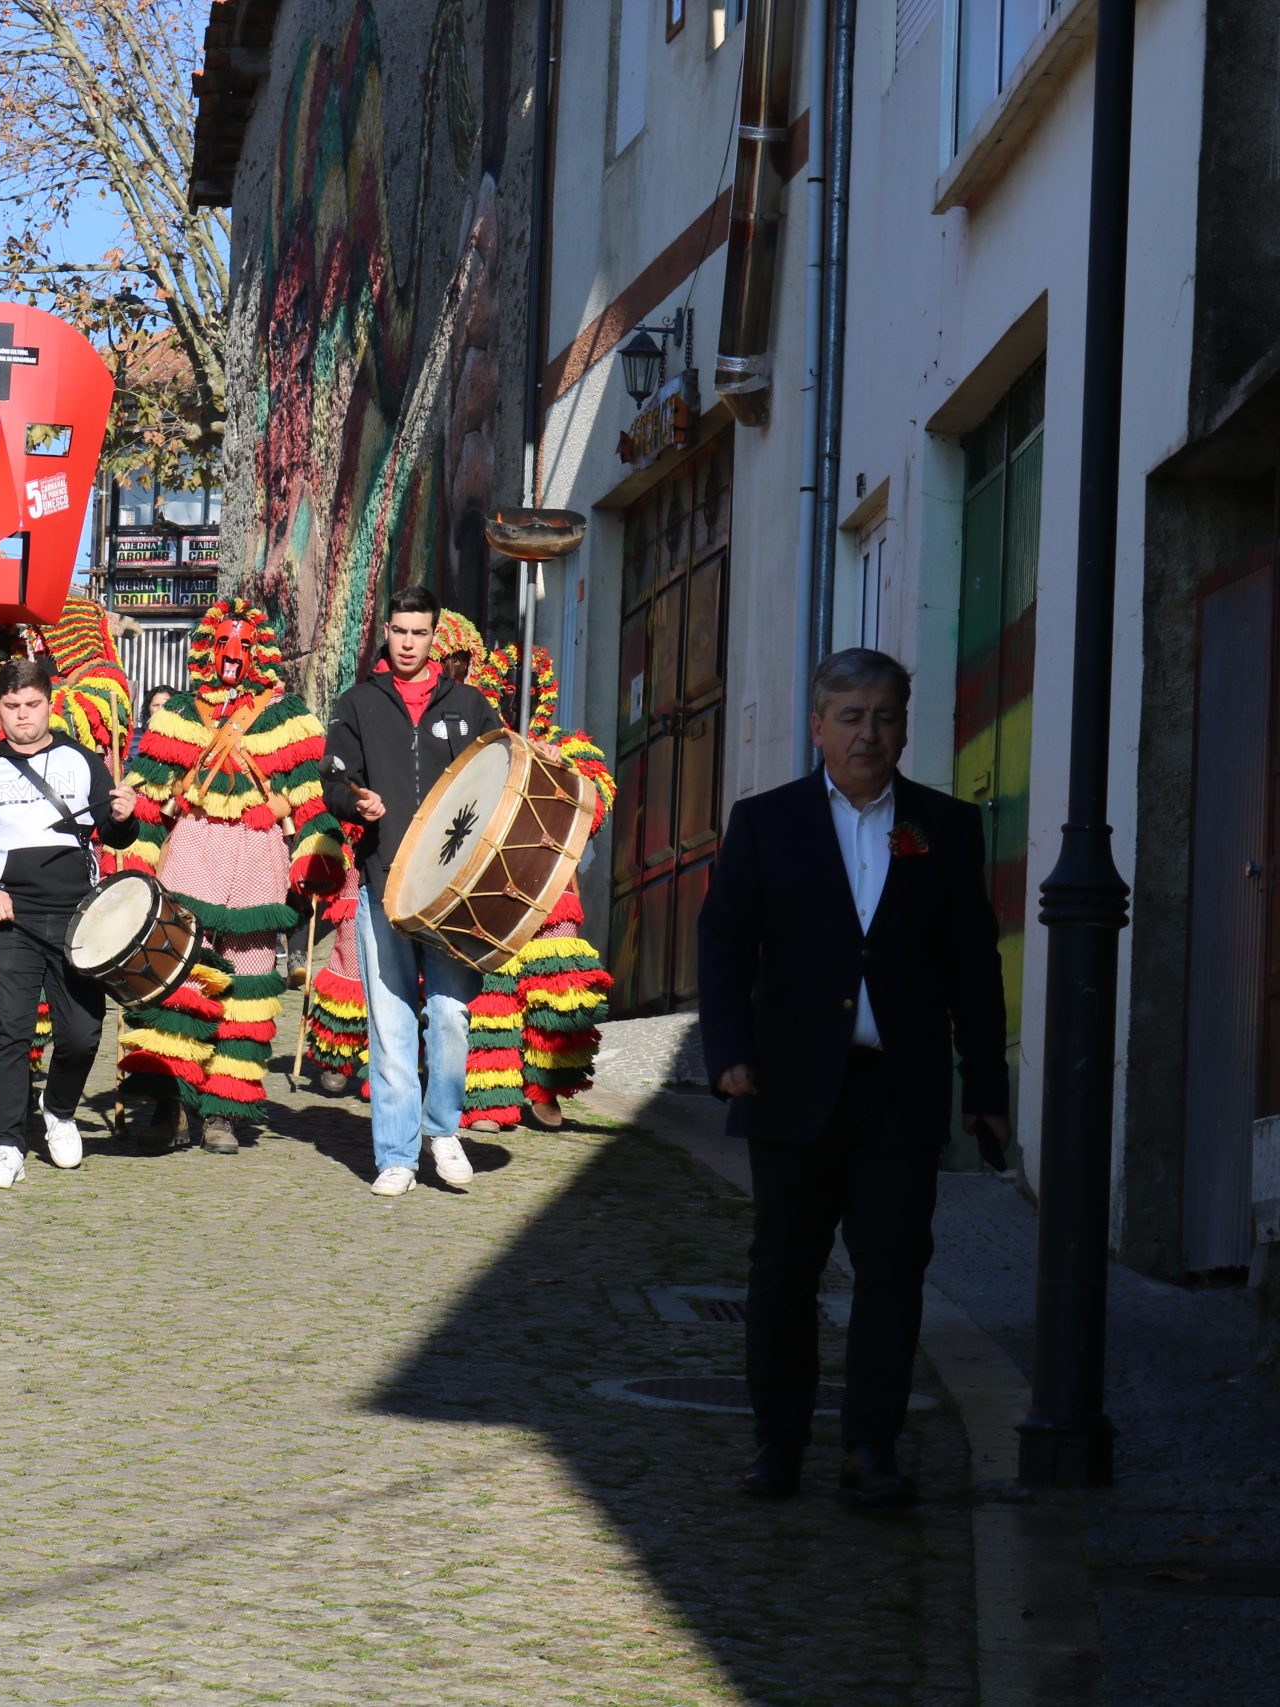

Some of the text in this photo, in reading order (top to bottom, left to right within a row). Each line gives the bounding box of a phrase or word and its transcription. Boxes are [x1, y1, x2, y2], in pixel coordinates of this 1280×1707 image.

[40, 479, 67, 494] CARNAVAL
[26, 480, 43, 519] 5
[42, 495, 69, 511] UNESCO
[118, 542, 157, 550] ABERNA
[117, 551, 170, 562] AROLINO
[189, 551, 220, 561] CARO
